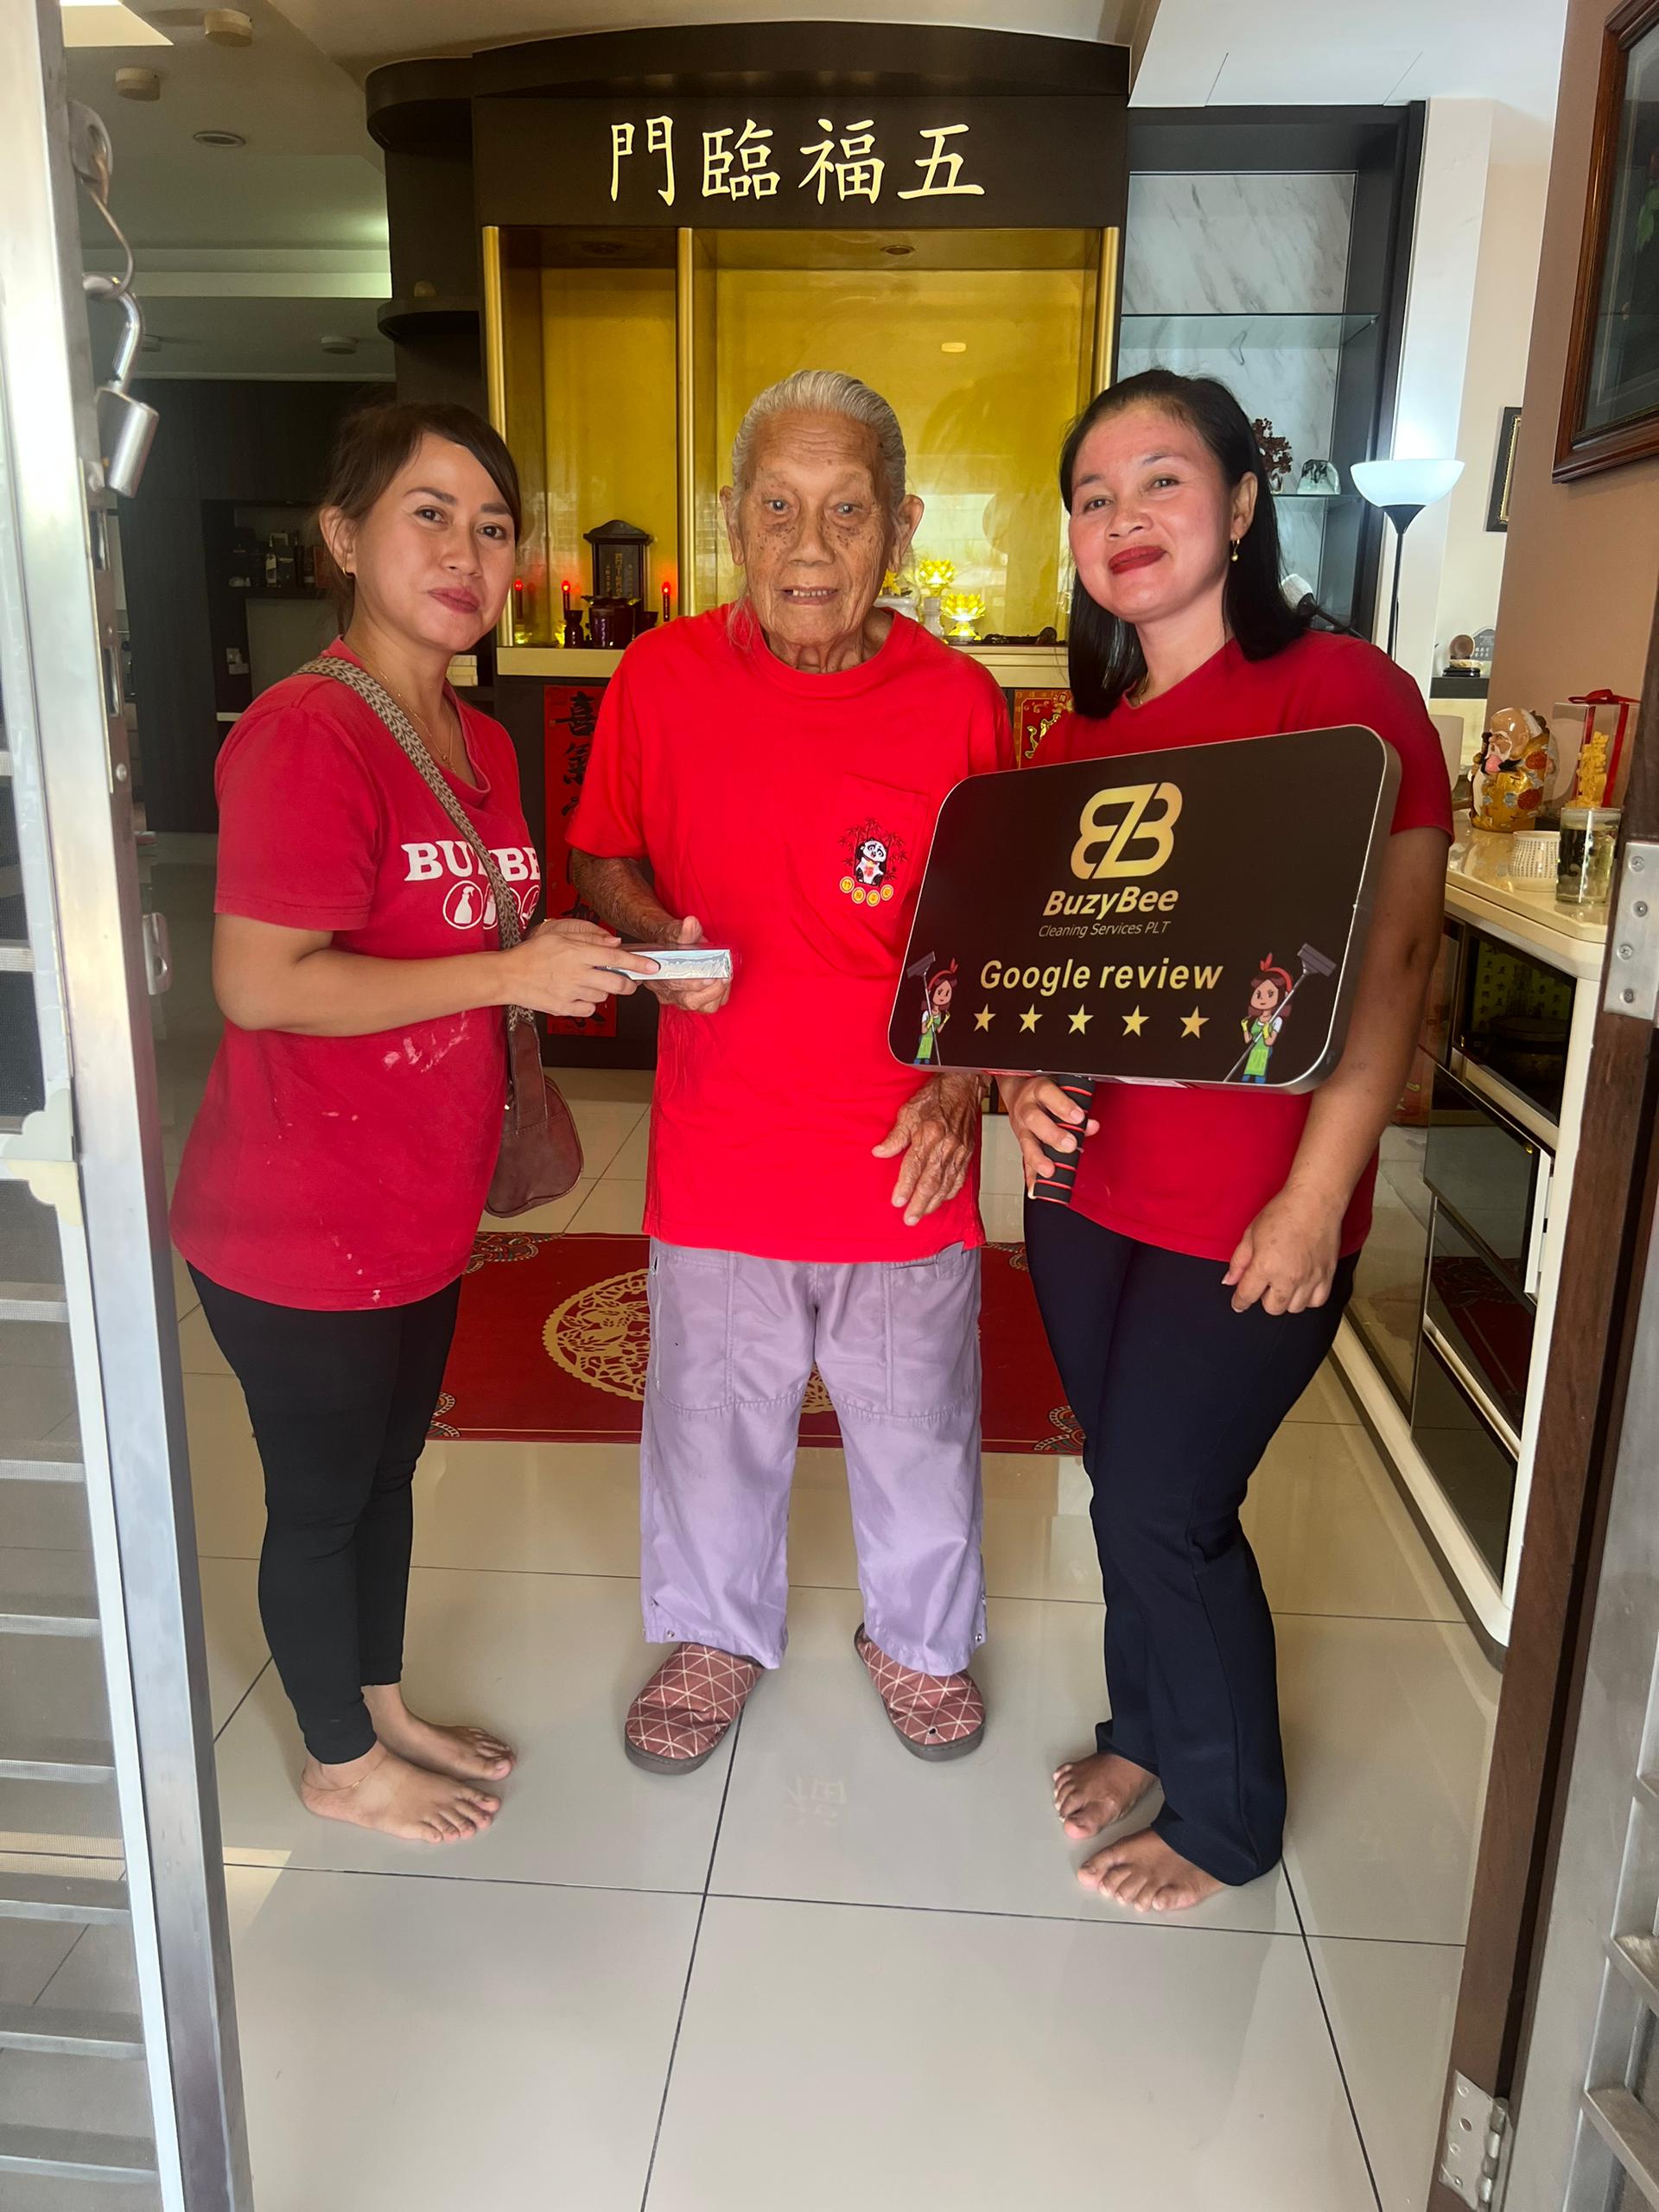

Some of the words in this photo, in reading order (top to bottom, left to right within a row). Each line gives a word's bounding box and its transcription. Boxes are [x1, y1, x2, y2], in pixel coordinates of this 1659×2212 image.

[1042, 886, 1179, 920] BuzyBee
[1038, 923, 1089, 938] Cleaning
[1090, 922, 1143, 936] Services
[1144, 920, 1172, 934] PLT
[980, 958, 1091, 997] Google
[1099, 957, 1224, 989] review
